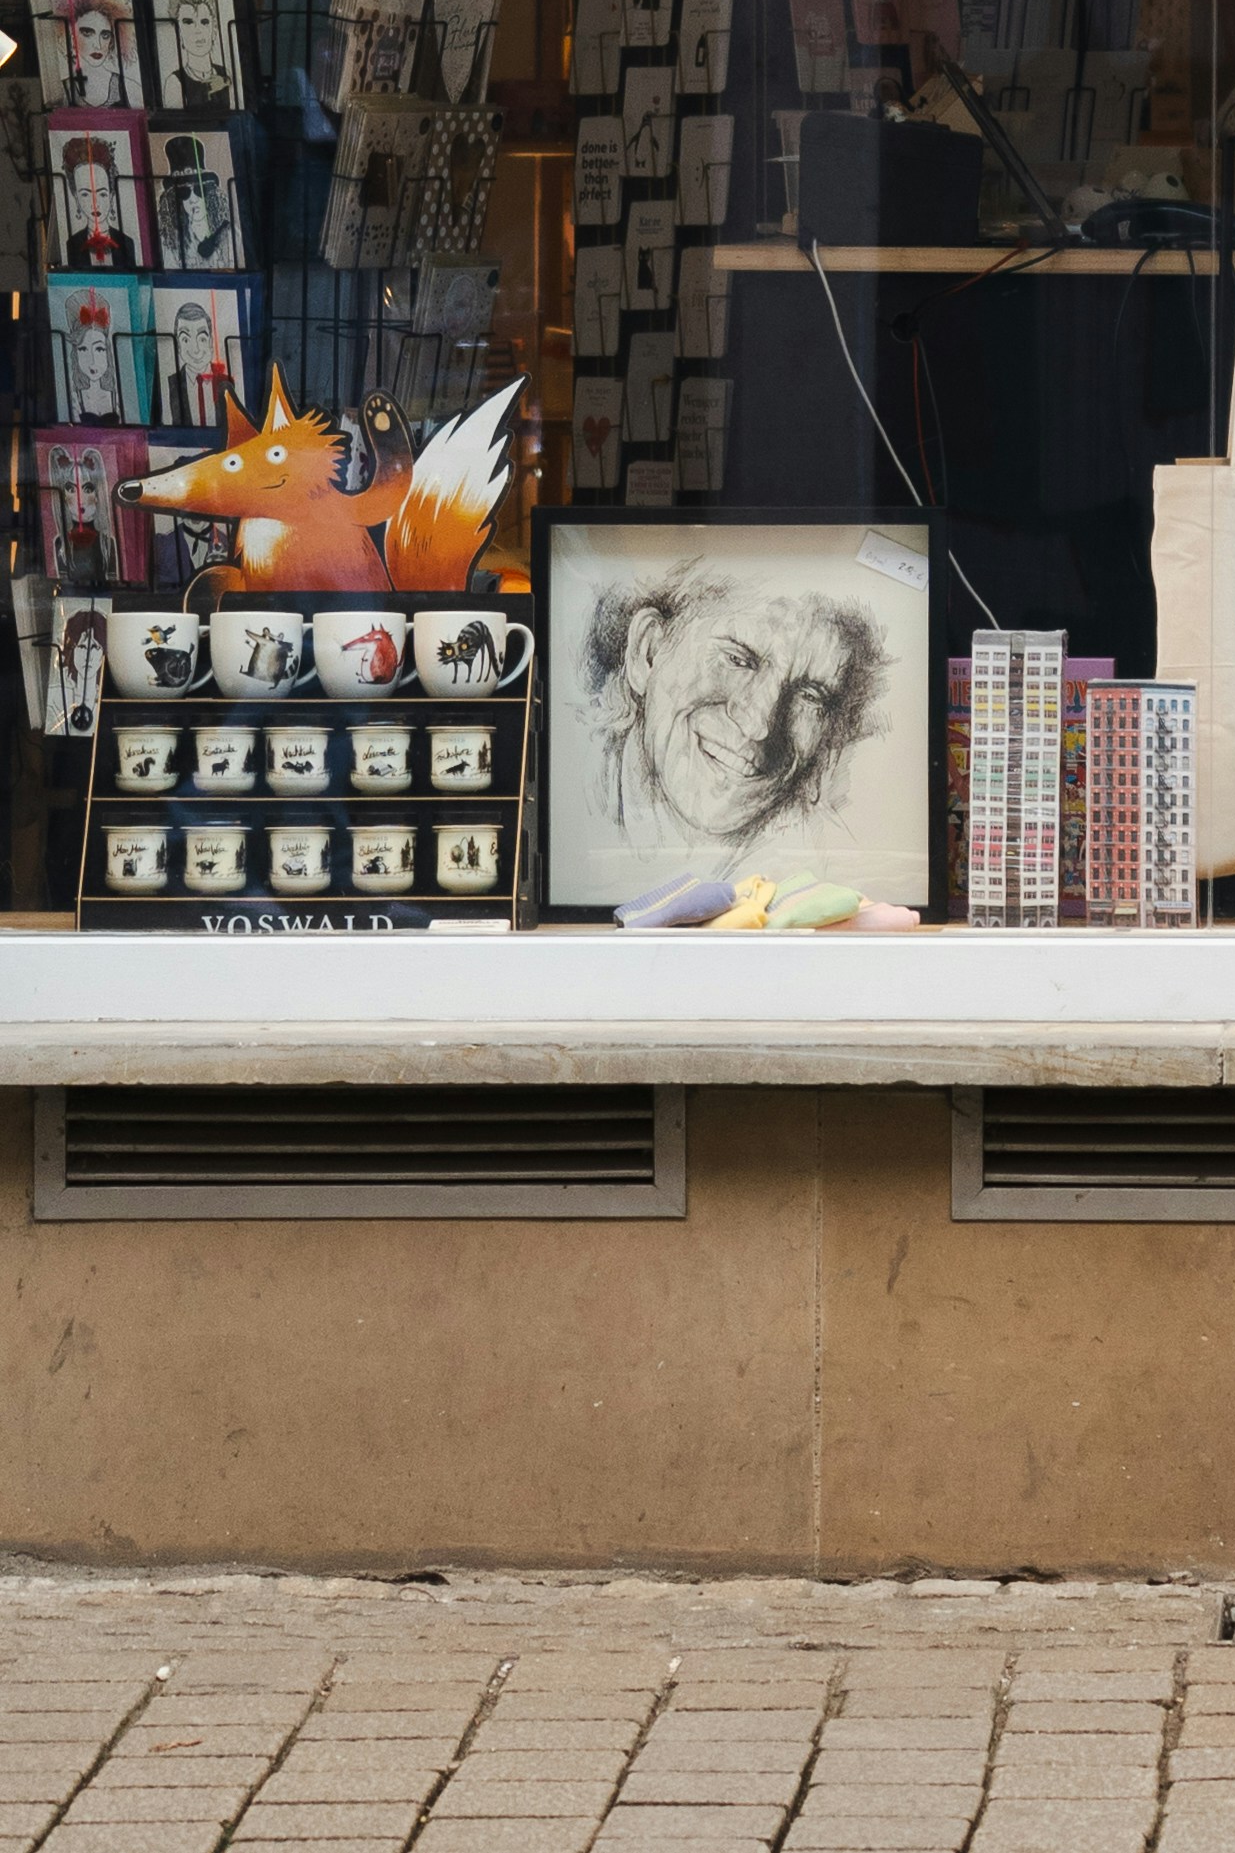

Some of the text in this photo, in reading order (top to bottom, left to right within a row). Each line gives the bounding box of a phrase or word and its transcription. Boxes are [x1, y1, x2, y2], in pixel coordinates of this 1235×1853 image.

[581, 139, 618, 154] done is
[584, 172, 608, 184] than
